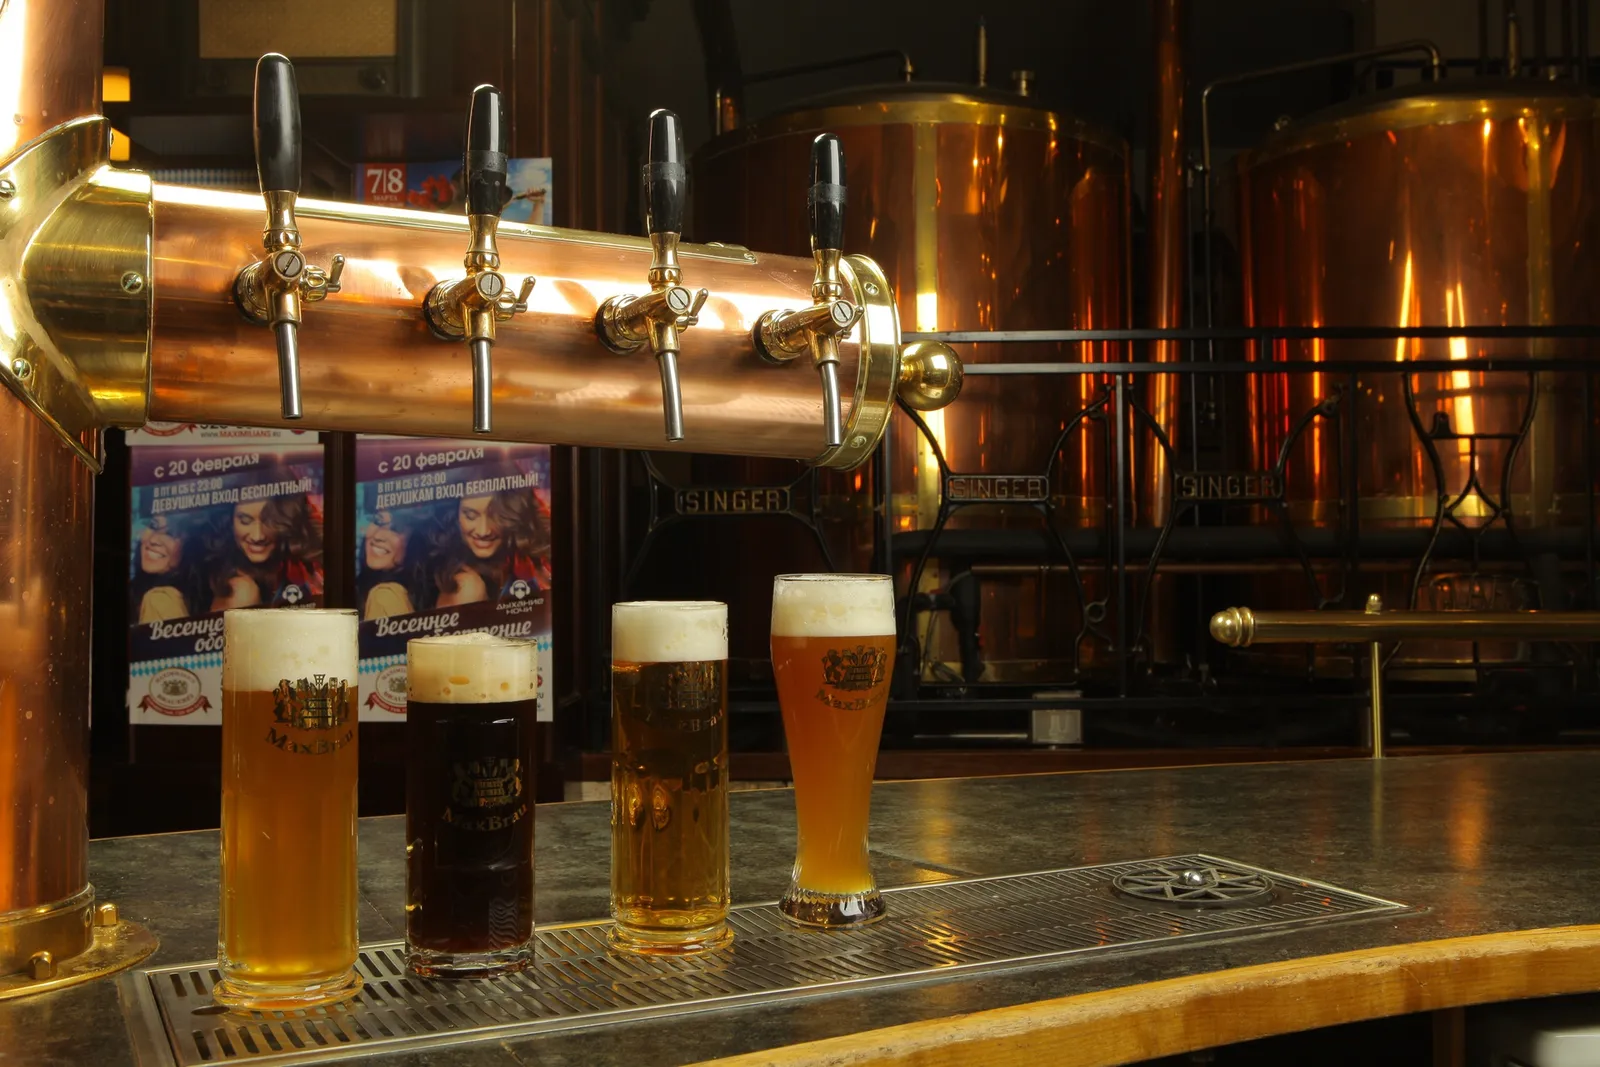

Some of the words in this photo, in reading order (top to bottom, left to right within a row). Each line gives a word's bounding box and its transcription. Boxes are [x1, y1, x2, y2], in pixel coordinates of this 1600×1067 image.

[169, 460, 188, 476] 20
[192, 453, 260, 475] февраля
[393, 454, 411, 471] 20
[415, 447, 485, 470] февраля
[197, 477, 223, 491] 23:00
[376, 487, 434, 509] ДЕВУШКАМ
[436, 484, 464, 500] ВХОД
[466, 471, 539, 495] БЕСПЛАТНЫЙ!
[421, 472, 446, 486] 23:00
[953, 478, 1042, 498] SINGER
[1181, 475, 1275, 497] SINGER
[151, 492, 210, 514] ДЕВУШКАМ
[212, 489, 240, 505] ВХОД
[241, 476, 313, 500] БЕСПЛАТНЫЙ!
[685, 489, 780, 512] SINGER
[150, 617, 224, 640] Весенне
[375, 612, 460, 637] Весеннее
